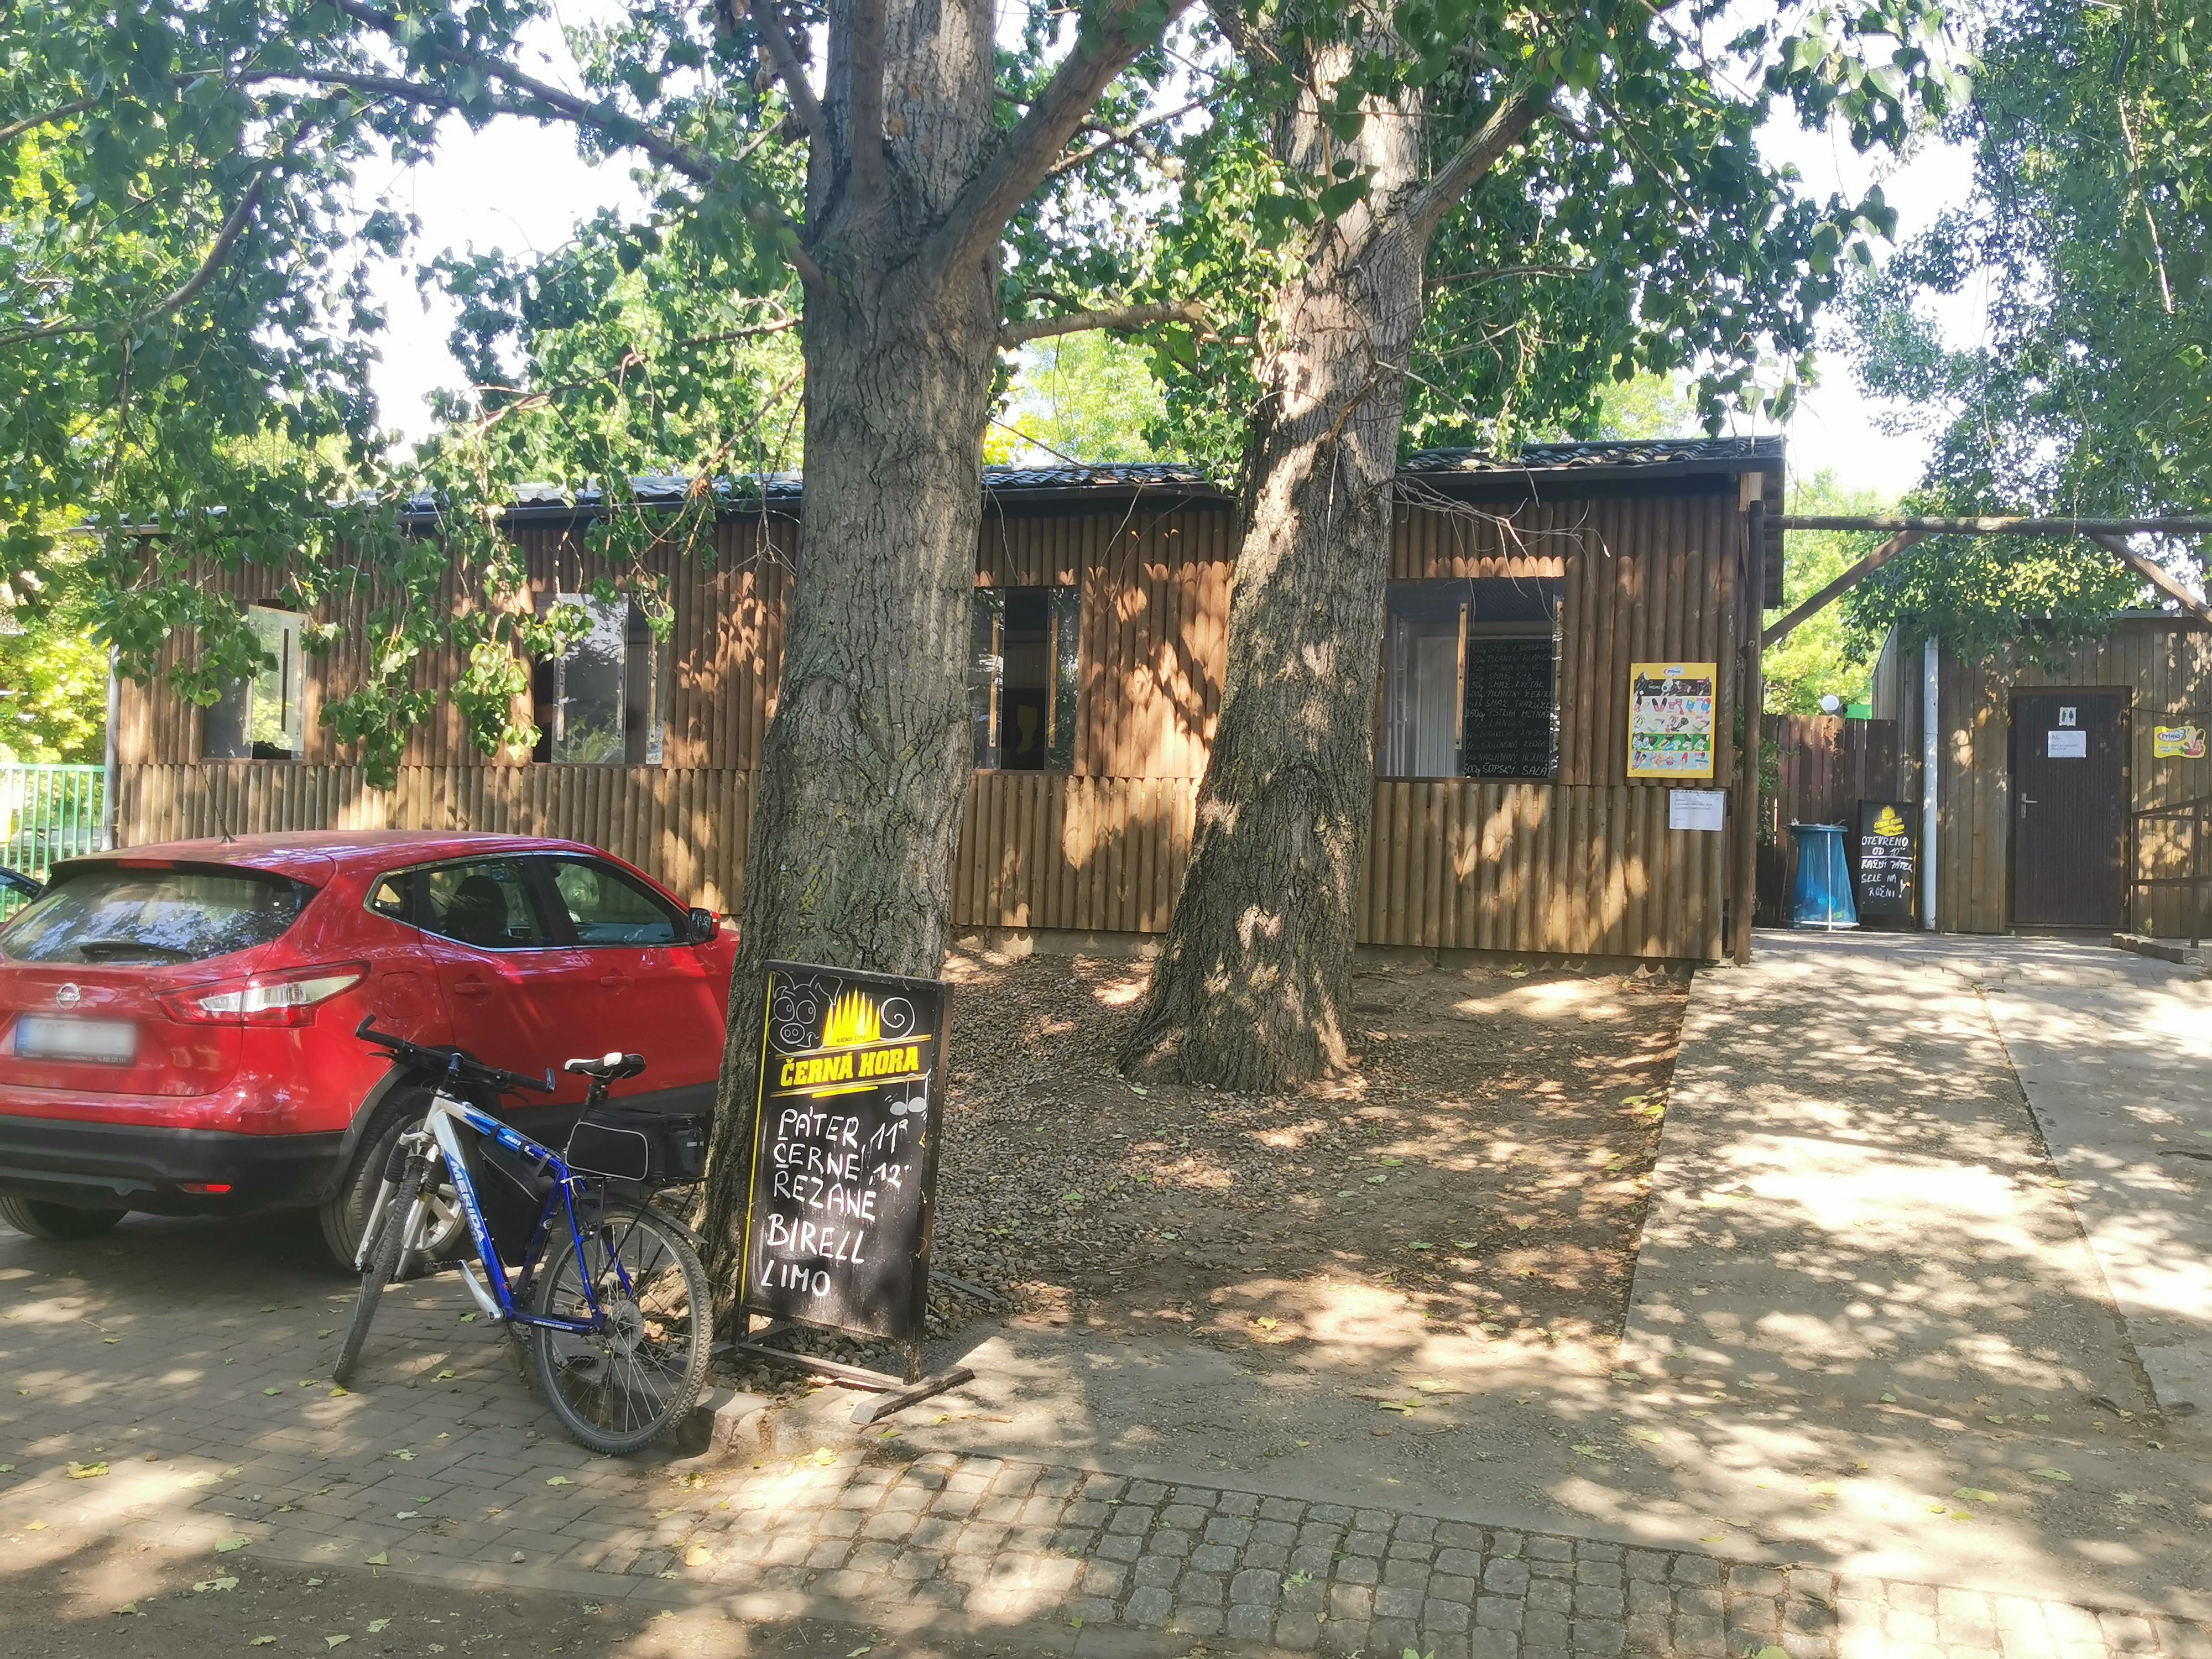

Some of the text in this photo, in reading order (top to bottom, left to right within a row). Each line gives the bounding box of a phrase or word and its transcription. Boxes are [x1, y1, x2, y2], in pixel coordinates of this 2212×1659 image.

[1872, 847, 1885, 855] OD
[1861, 873, 1897, 884] SELE NA
[780, 1046, 919, 1087] ČERNÁ HORA
[779, 1106, 859, 1149] PÁTER
[450, 1161, 485, 1243] MERIDA
[767, 1213, 865, 1264] BIRELL
[760, 1259, 830, 1297] LIMO
